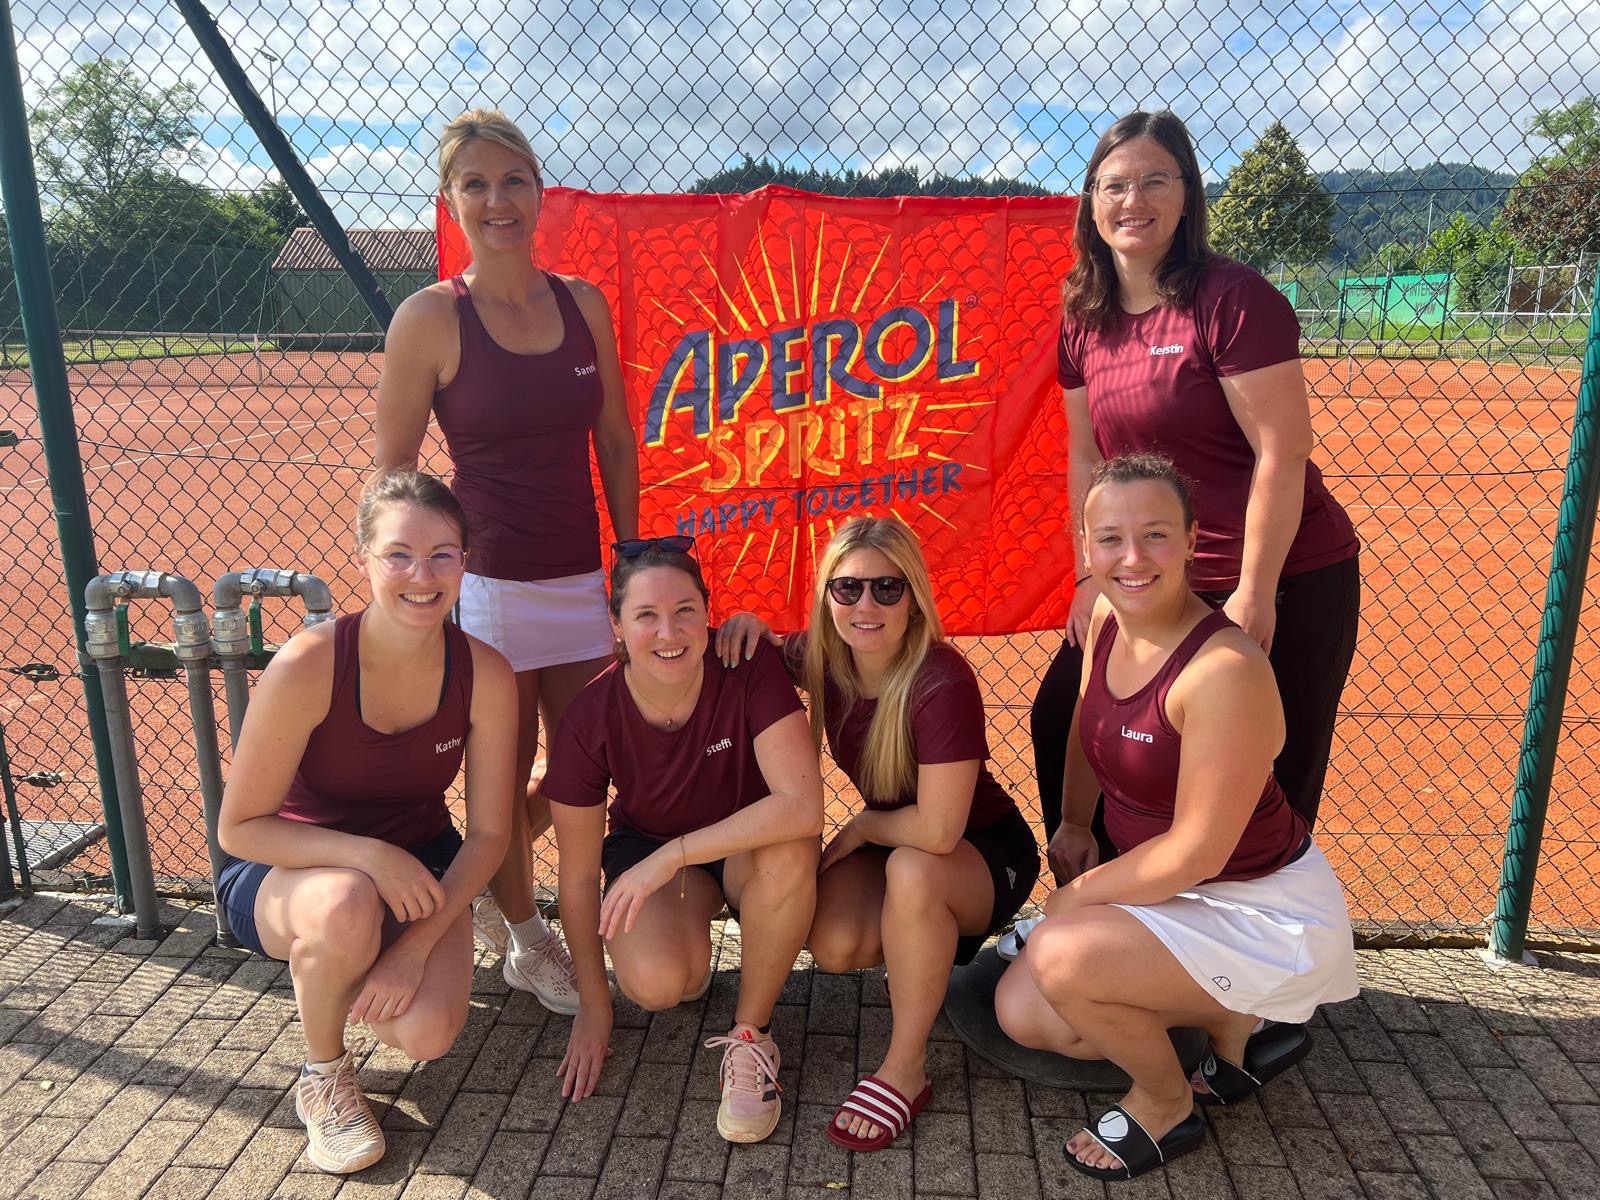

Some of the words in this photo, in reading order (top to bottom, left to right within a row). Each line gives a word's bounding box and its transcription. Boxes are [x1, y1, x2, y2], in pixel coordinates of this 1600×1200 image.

[1149, 343, 1184, 356] Kerstin
[643, 298, 981, 448] APEROL
[675, 496, 777, 539] HAPPY
[791, 462, 963, 522] TOGETHER
[1121, 725, 1154, 744] Laura
[435, 736, 462, 754] Kathy
[706, 737, 733, 756] Steffi
